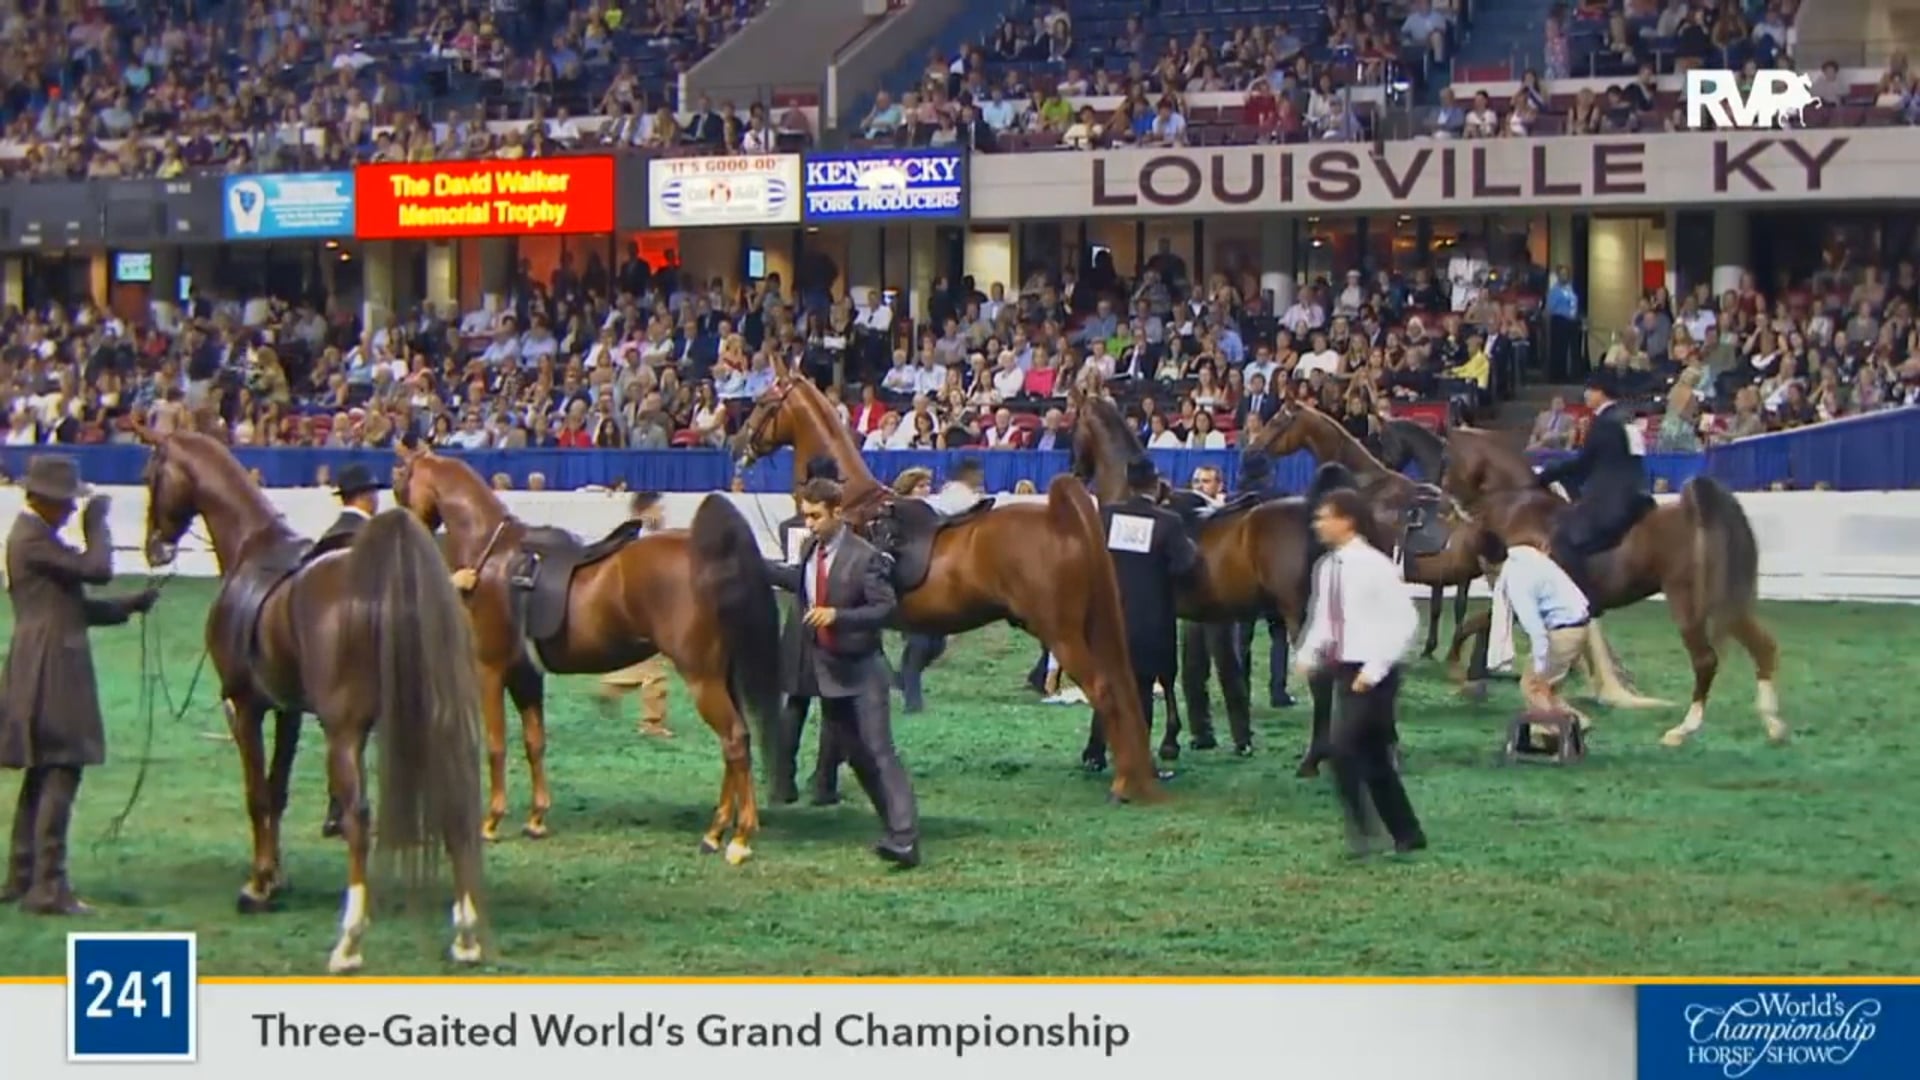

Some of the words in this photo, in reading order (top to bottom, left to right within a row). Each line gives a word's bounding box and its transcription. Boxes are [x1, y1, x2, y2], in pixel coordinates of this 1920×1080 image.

[390, 175, 431, 197] The
[435, 172, 491, 196] David
[495, 170, 570, 194] Walker
[1092, 143, 1646, 206] LOUISVILLE
[1715, 138, 1849, 192] KY
[399, 201, 491, 226] Memorial
[494, 199, 567, 228] Trophy
[810, 193, 854, 213] PORK
[858, 190, 959, 212] PRODUCERS
